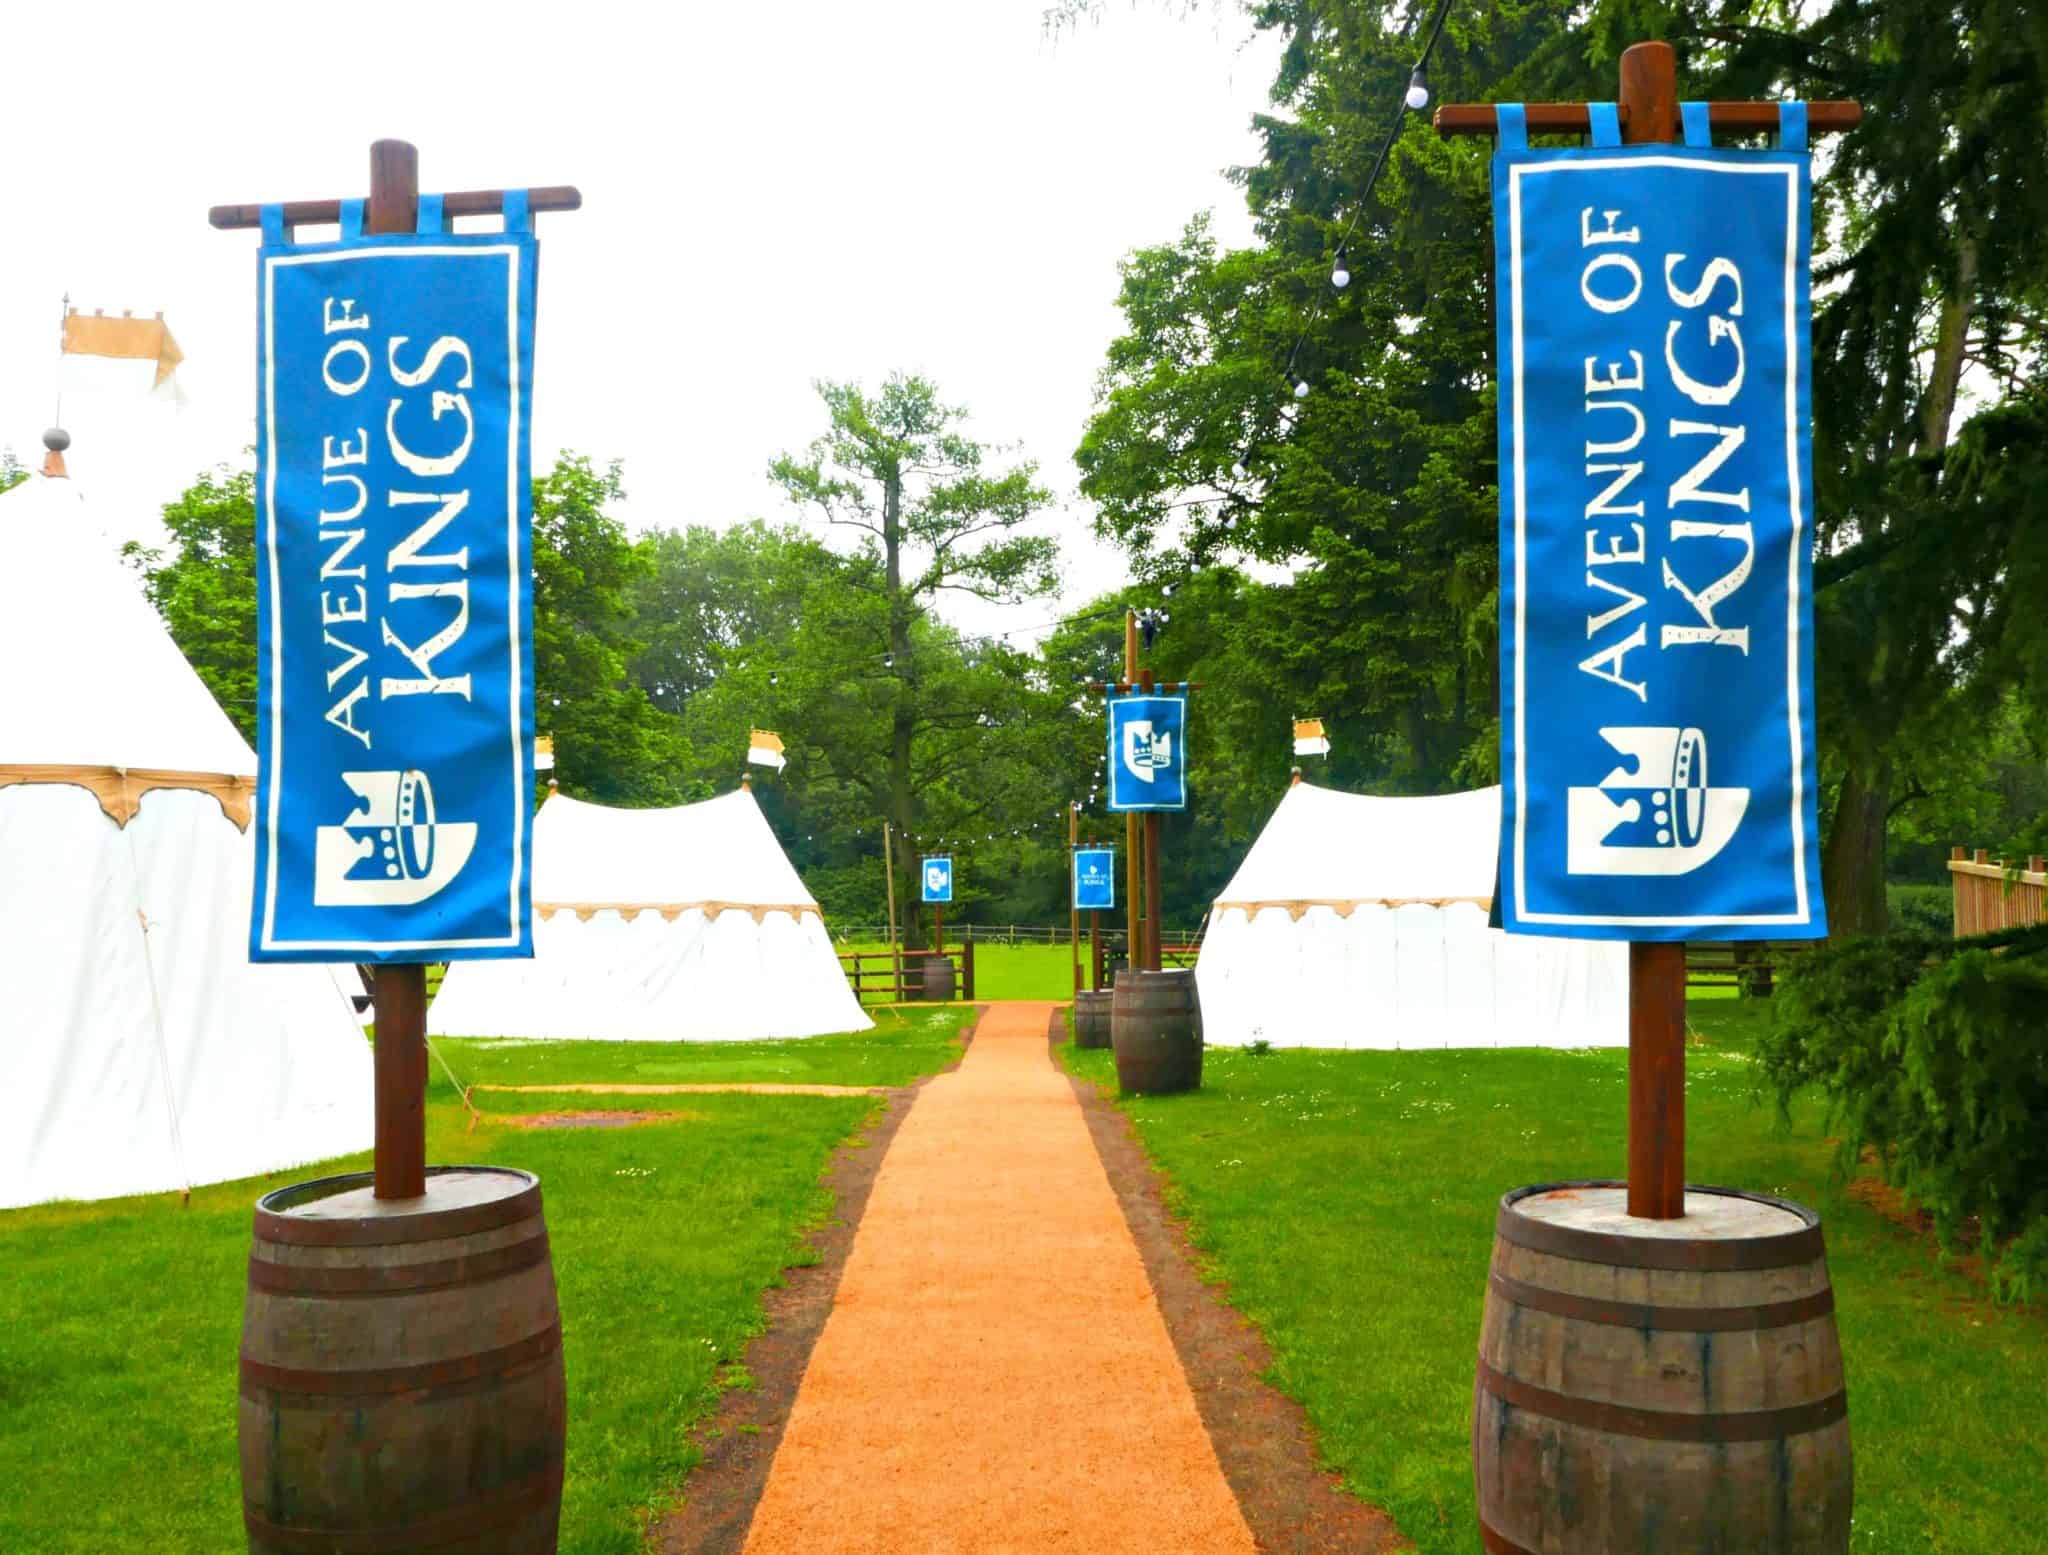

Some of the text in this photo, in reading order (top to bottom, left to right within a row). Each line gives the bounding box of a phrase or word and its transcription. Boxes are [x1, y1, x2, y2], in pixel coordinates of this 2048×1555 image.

[319, 297, 371, 750] AVENUE OF
[380, 335, 474, 702] KINGS
[1578, 207, 1647, 703] AVENUE OF
[1660, 253, 1755, 657] KINGS
